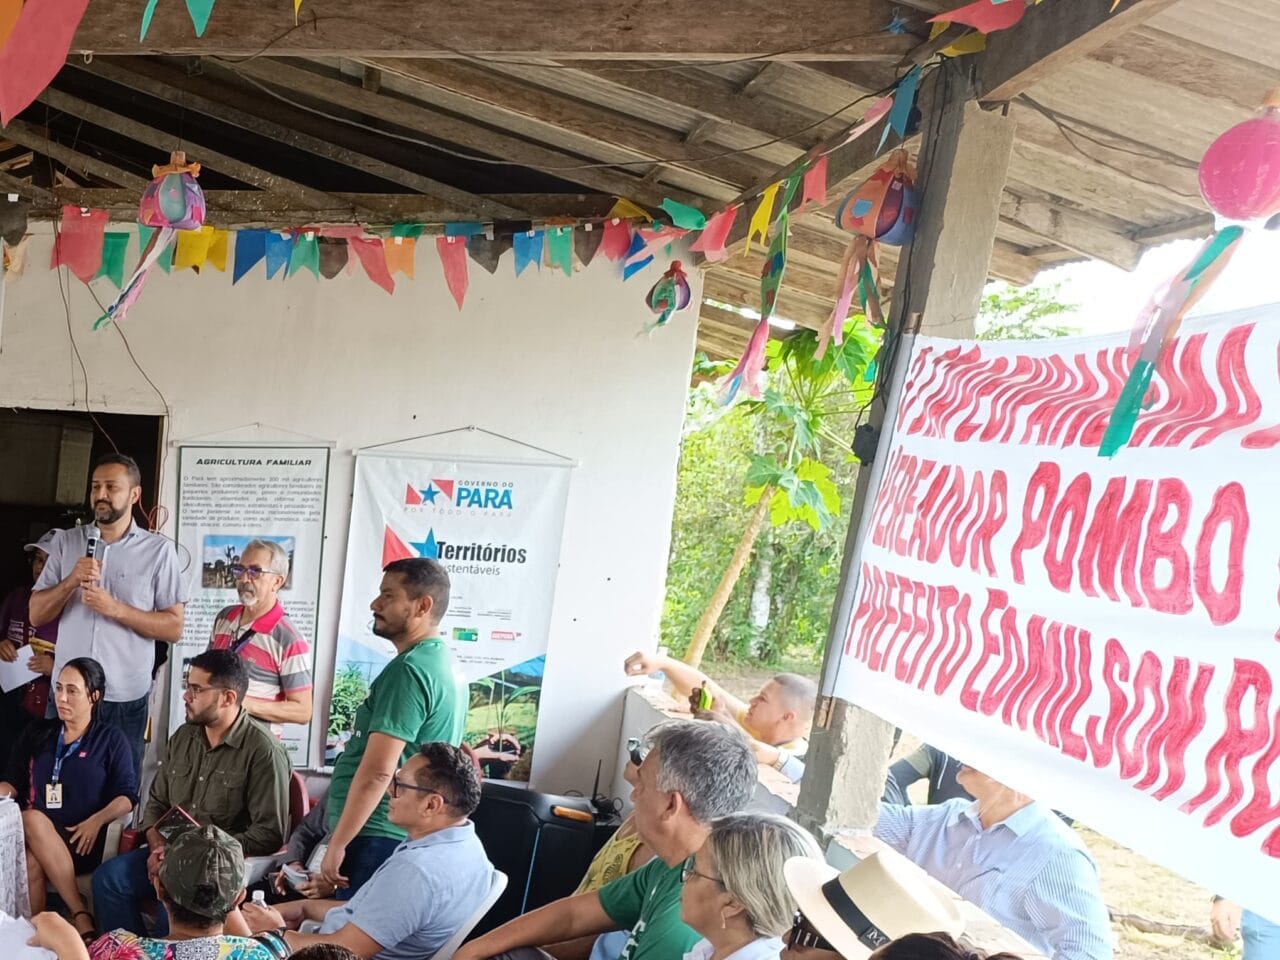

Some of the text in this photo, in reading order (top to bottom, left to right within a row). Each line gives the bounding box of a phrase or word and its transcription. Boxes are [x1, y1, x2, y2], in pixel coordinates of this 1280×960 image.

[195, 458, 312, 467] AGRICULTURA FAMILIAR
[458, 479, 498, 488] GOVERNO
[436, 540, 527, 564] Territórios
[1010, 461, 1250, 626] POMBO
[446, 563, 502, 576] stentáveis
[844, 559, 973, 698] PREFEITO
[960, 587, 1215, 801] EDMILSON
